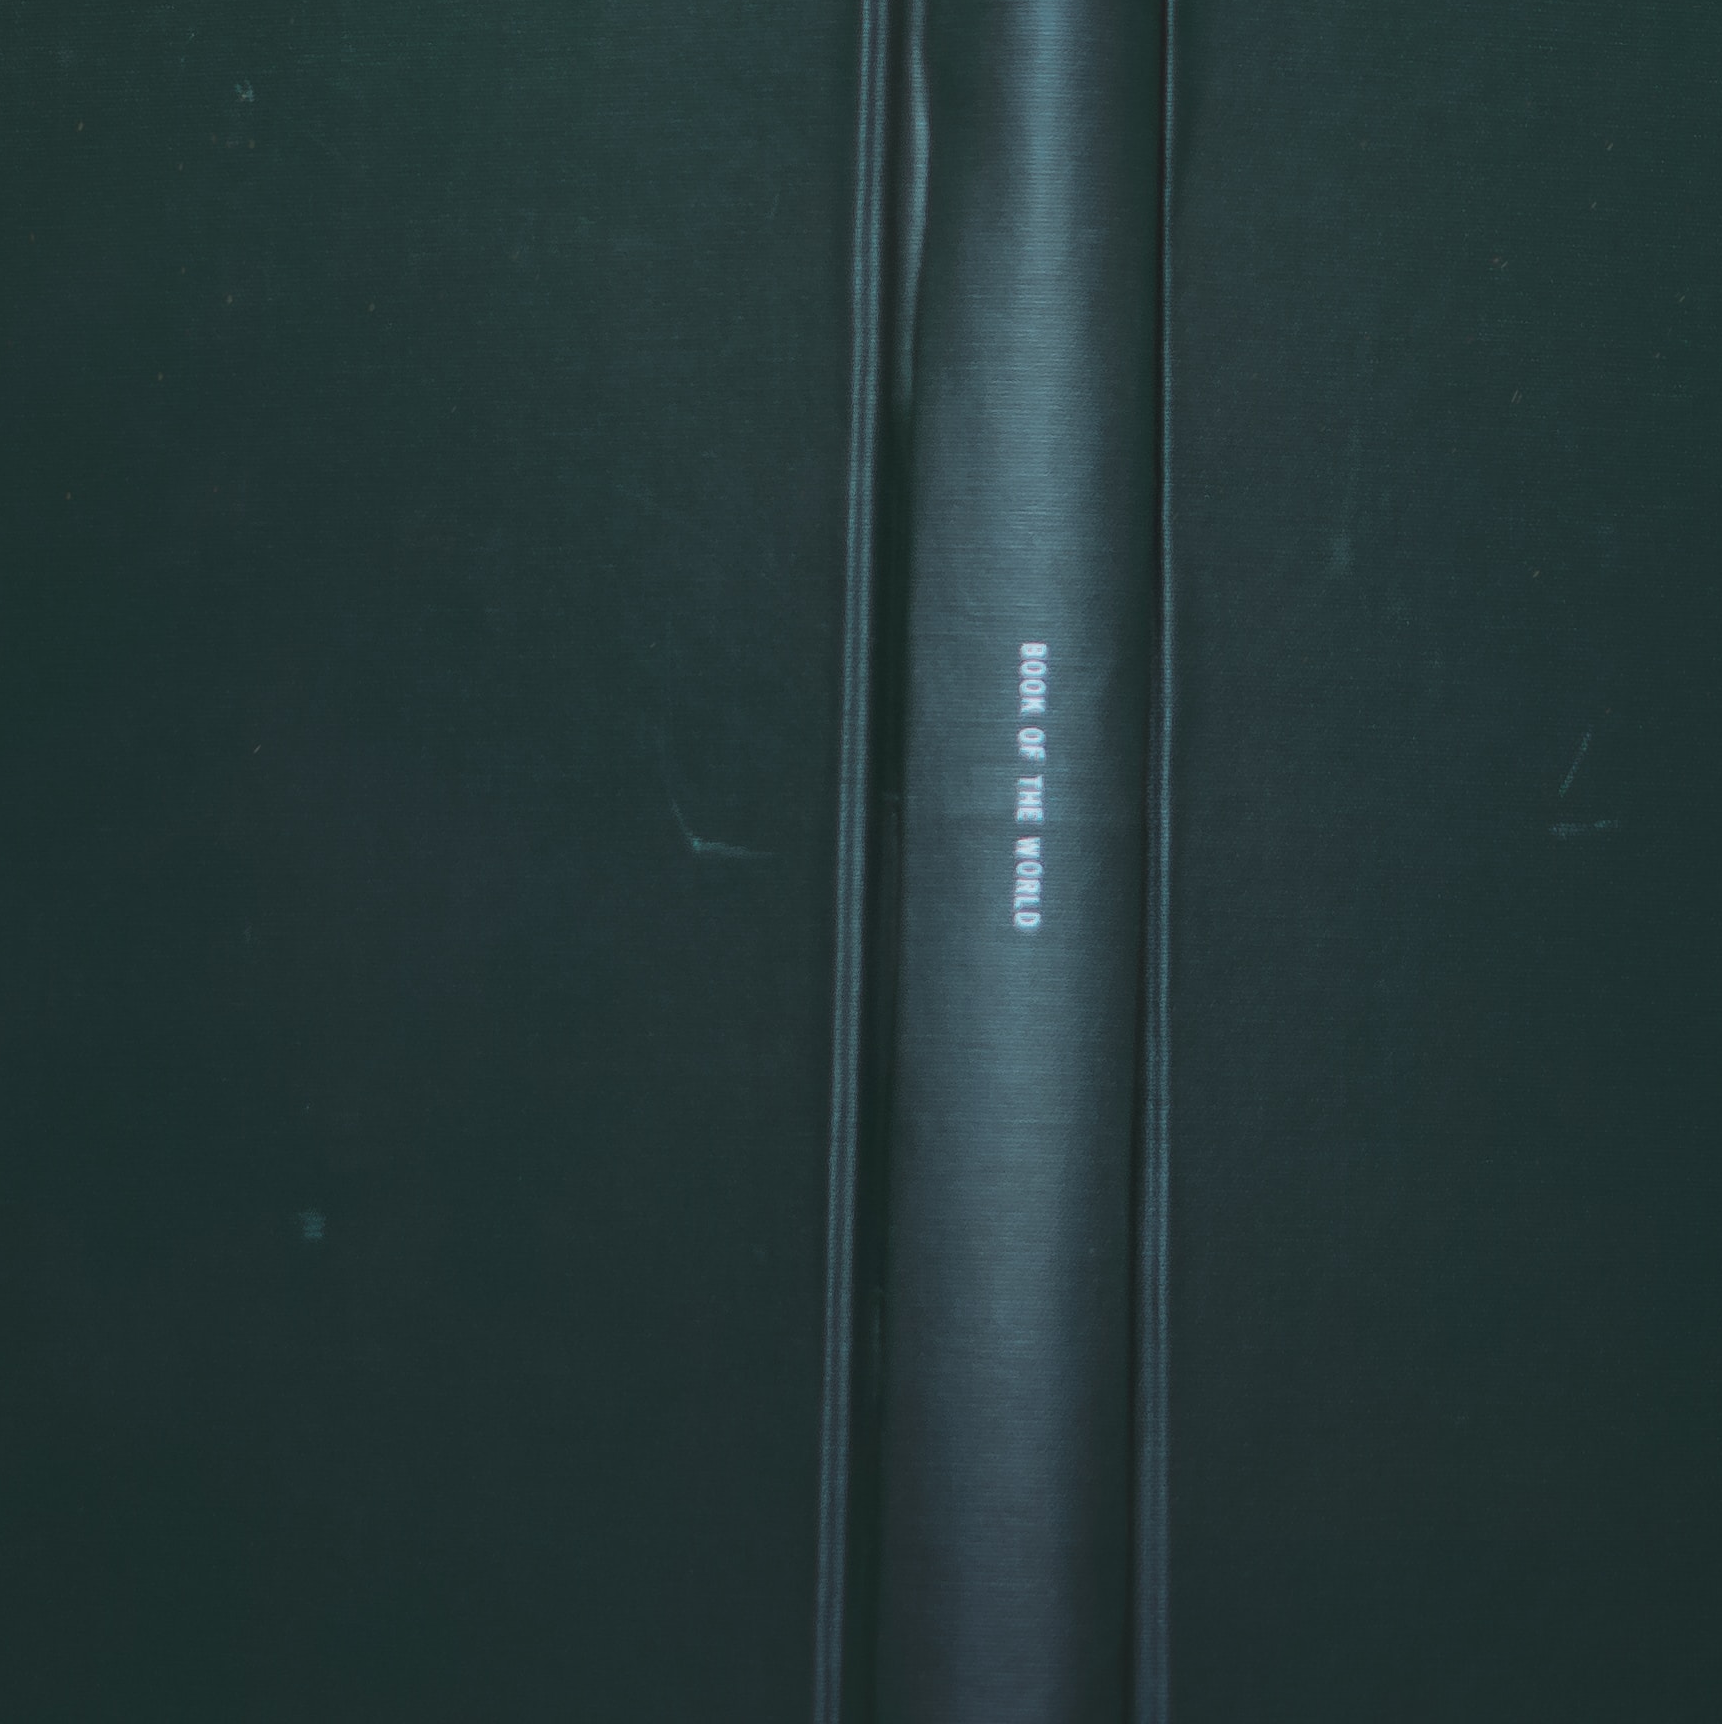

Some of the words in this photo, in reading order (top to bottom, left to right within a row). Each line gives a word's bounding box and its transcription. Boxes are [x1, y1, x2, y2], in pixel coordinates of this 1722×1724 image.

[1019, 642, 1048, 714] BOOK
[1017, 726, 1046, 762] OF
[1016, 774, 1045, 824] THE
[1013, 836, 1044, 928] WORLD
